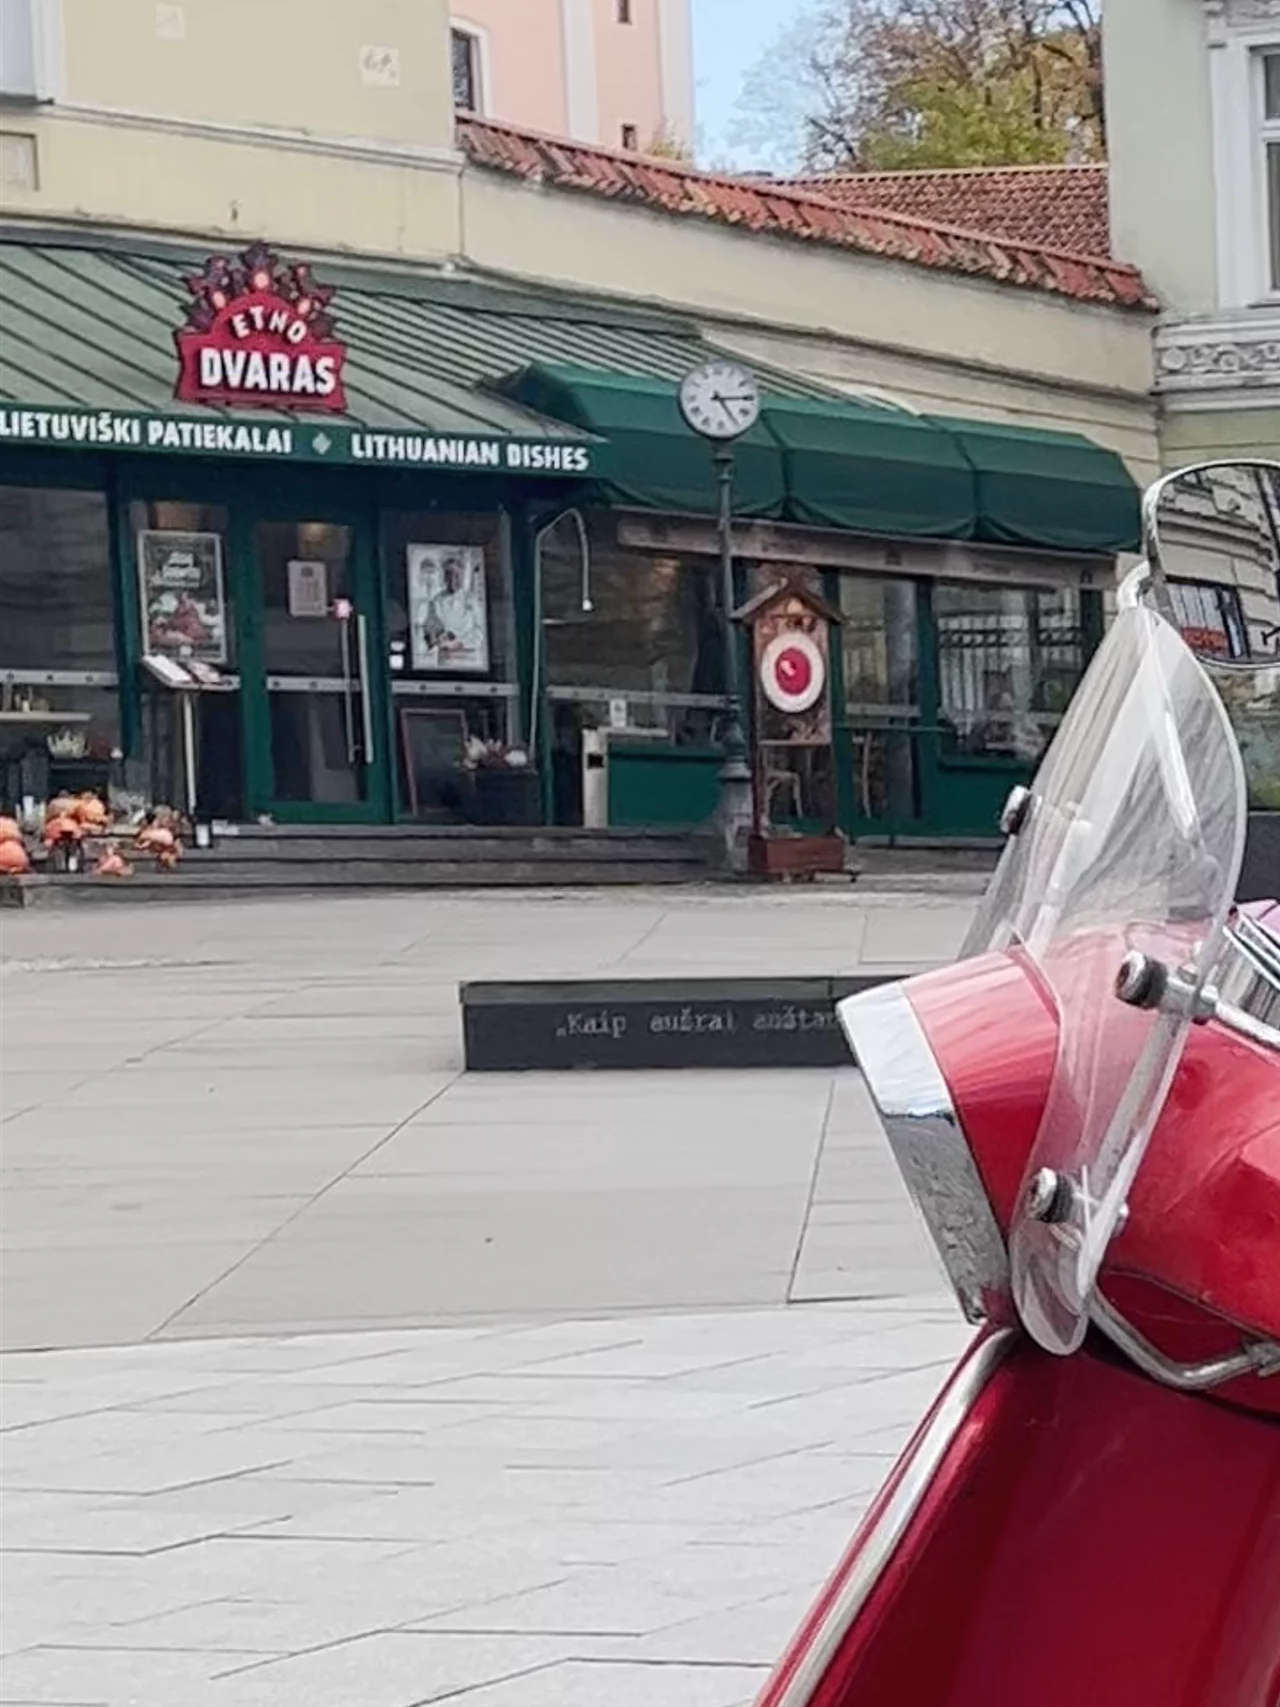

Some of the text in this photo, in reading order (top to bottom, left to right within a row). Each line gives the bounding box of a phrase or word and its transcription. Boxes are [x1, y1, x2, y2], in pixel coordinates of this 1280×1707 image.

[231, 305, 307, 343] ETNO
[200, 347, 336, 394] DVARAS
[0, 410, 292, 453] LIETUVIŠKI PATIEKALAI
[351, 434, 590, 471] LITHUANIAN DISHES
